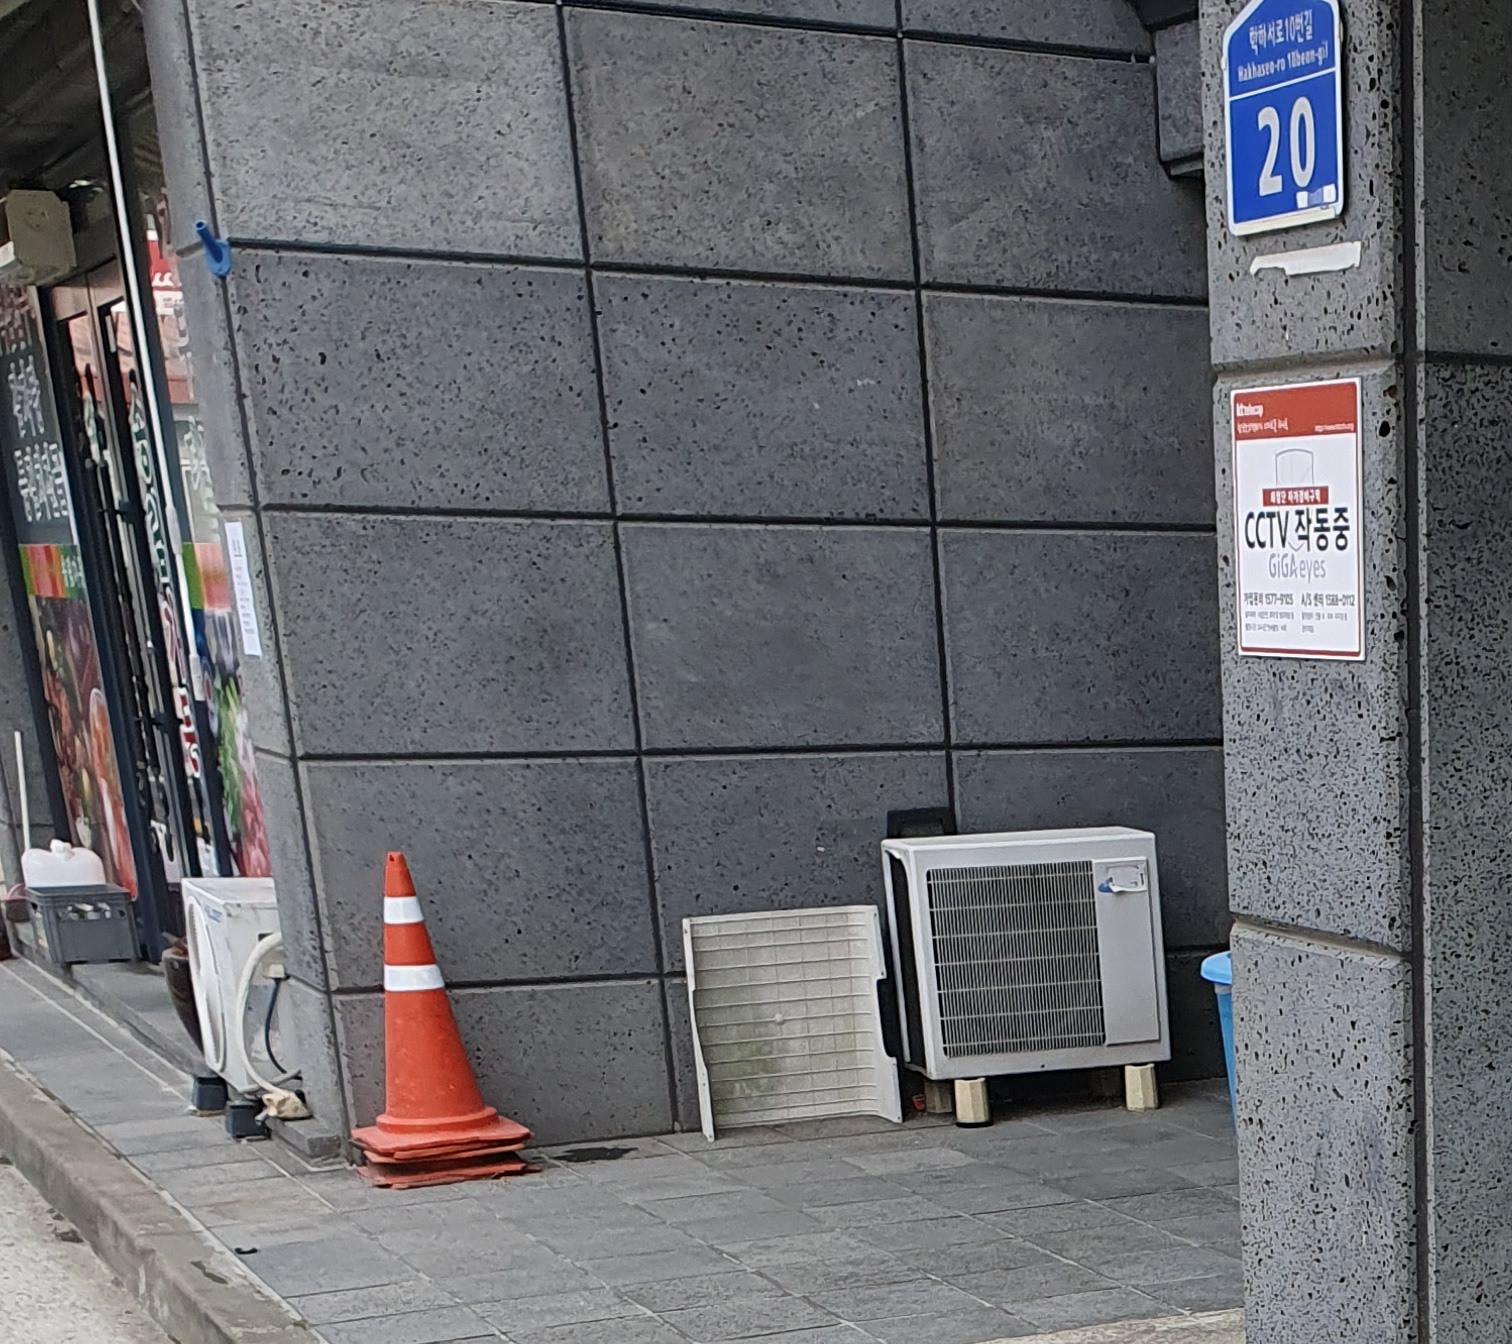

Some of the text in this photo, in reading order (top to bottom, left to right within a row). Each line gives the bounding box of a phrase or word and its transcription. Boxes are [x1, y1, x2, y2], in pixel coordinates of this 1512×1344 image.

[1257, 96, 1316, 197] 20
[1244, 506, 1350, 552] CCTV 작동중
